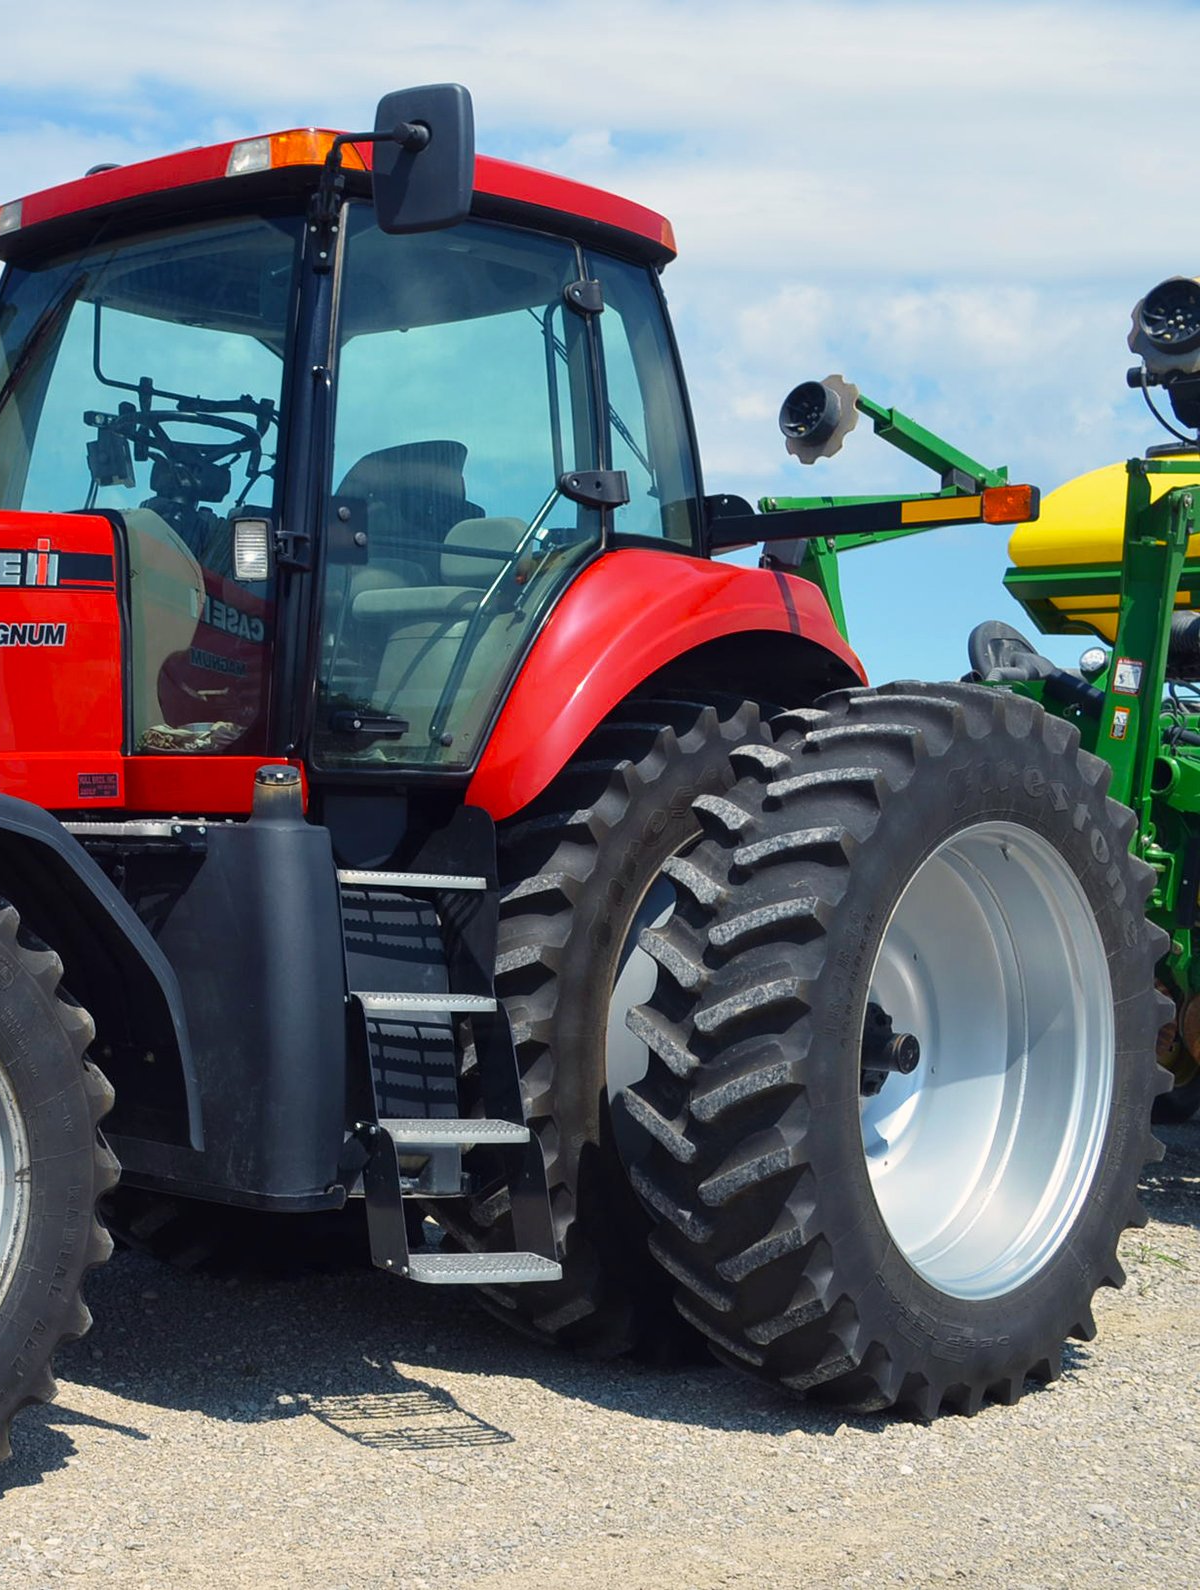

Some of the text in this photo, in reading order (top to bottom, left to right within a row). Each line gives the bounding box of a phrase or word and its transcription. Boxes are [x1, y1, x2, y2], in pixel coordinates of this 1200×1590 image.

[945, 758, 1139, 948] Firestone
[47, 1184, 82, 1299] RADIAL
[10, 1318, 48, 1377] ALL
